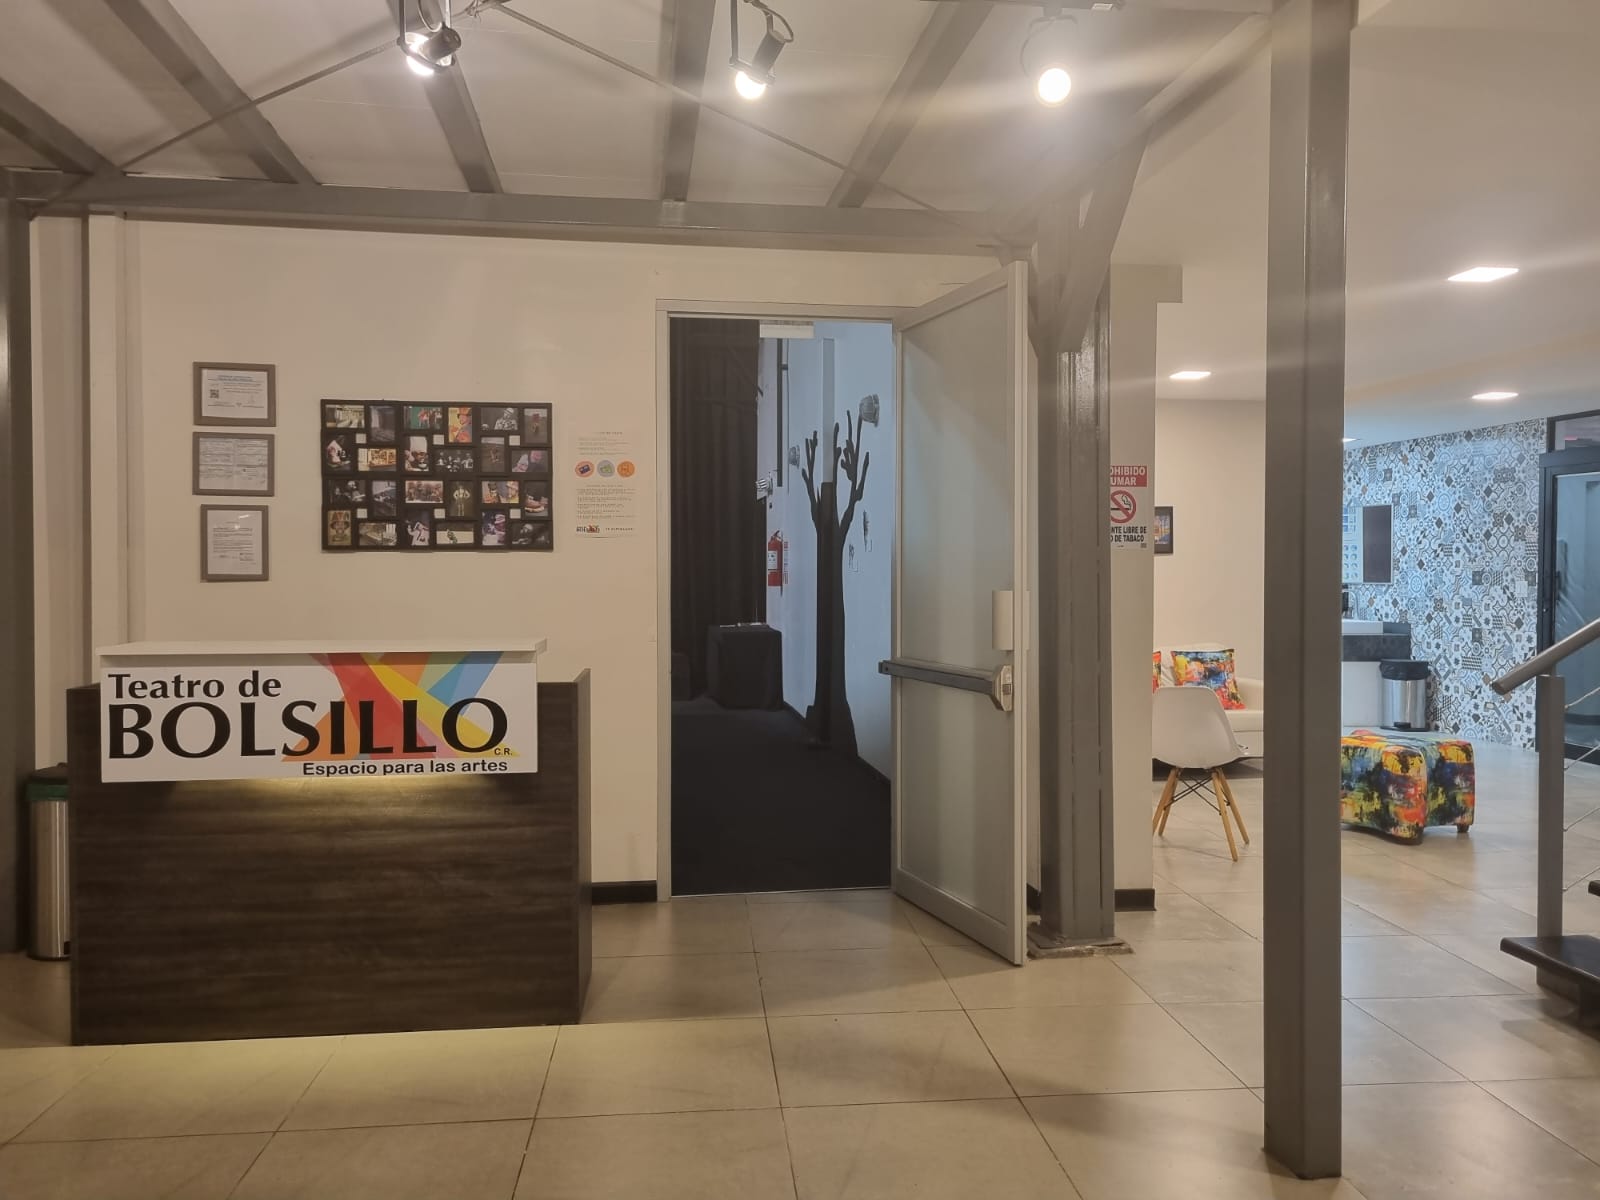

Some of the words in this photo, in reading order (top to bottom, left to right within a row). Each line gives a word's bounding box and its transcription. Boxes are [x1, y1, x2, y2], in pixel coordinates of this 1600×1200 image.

[1110, 466, 1146, 476] OHIBIDO
[1110, 476, 1137, 485] UMAR
[1123, 526, 1138, 534] LIBRE
[1139, 526, 1147, 534] DE
[1114, 534, 1122, 542] DE
[1123, 534, 1145, 542] TABACO
[108, 673, 225, 699] Teatro
[238, 670, 282, 698] de
[108, 697, 508, 759] BOLSILLO
[494, 747, 513, 756] C.R.
[303, 762, 380, 777] Espacio
[382, 763, 426, 776] para
[429, 759, 458, 773] las
[461, 760, 508, 773] artes
